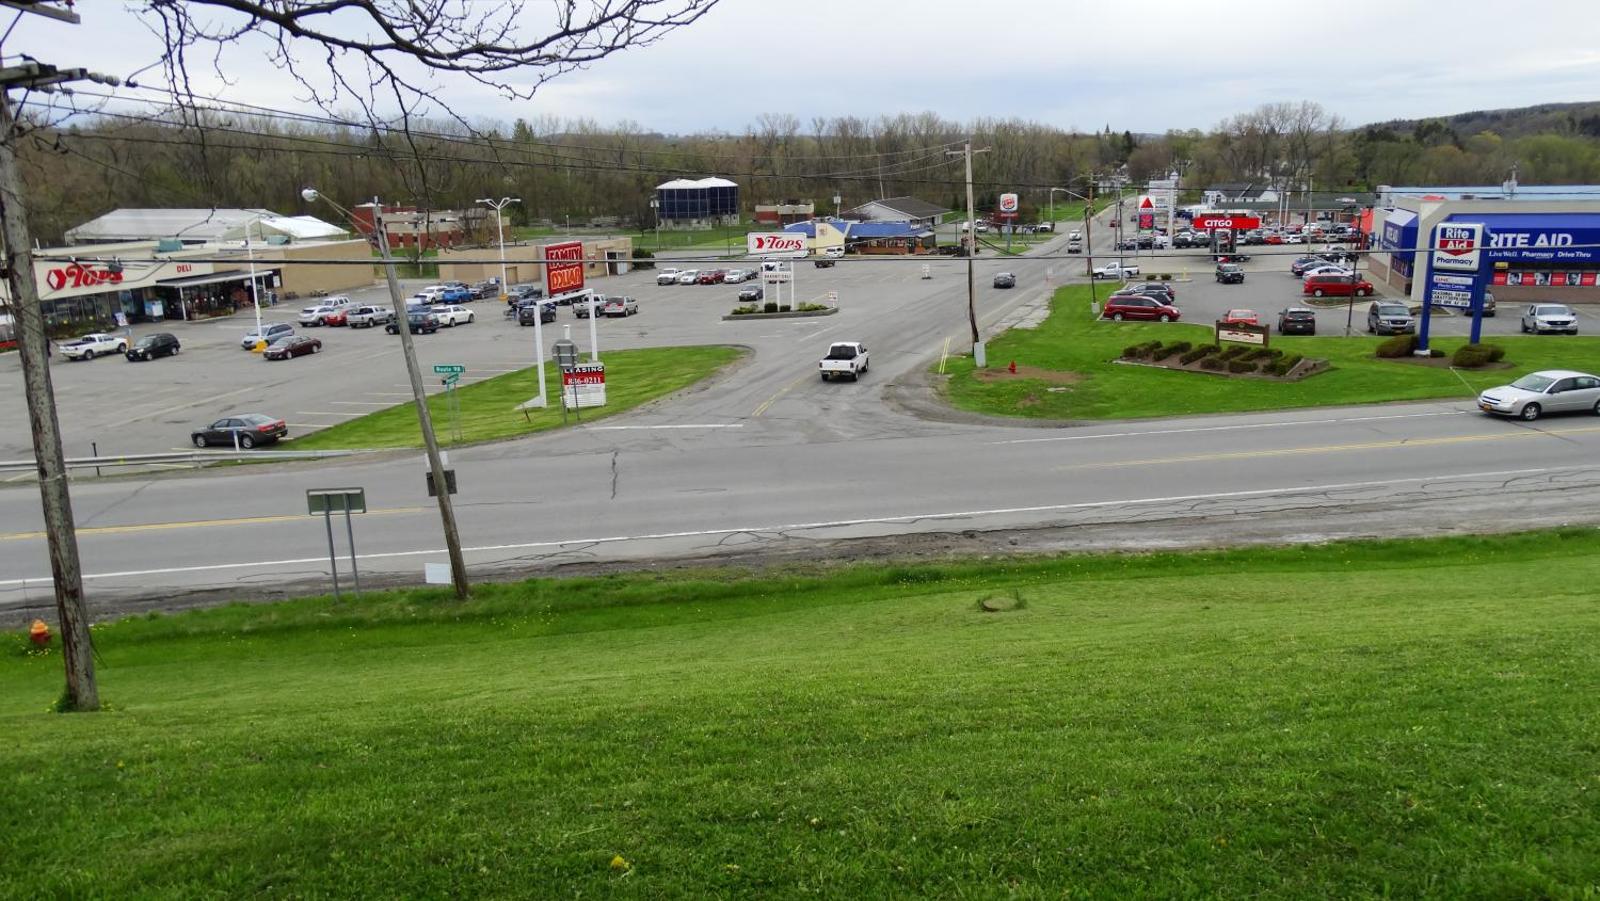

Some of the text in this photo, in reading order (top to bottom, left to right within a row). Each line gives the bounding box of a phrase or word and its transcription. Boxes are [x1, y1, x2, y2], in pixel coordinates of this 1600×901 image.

[1204, 219, 1232, 227] CITGO
[1445, 227, 1470, 239] Rite
[1447, 240, 1468, 250] Aid
[1534, 233, 1573, 248] AID
[548, 246, 581, 269] FAMILY
[1436, 256, 1473, 266] Pharmacy
[176, 264, 192, 273] DELI
